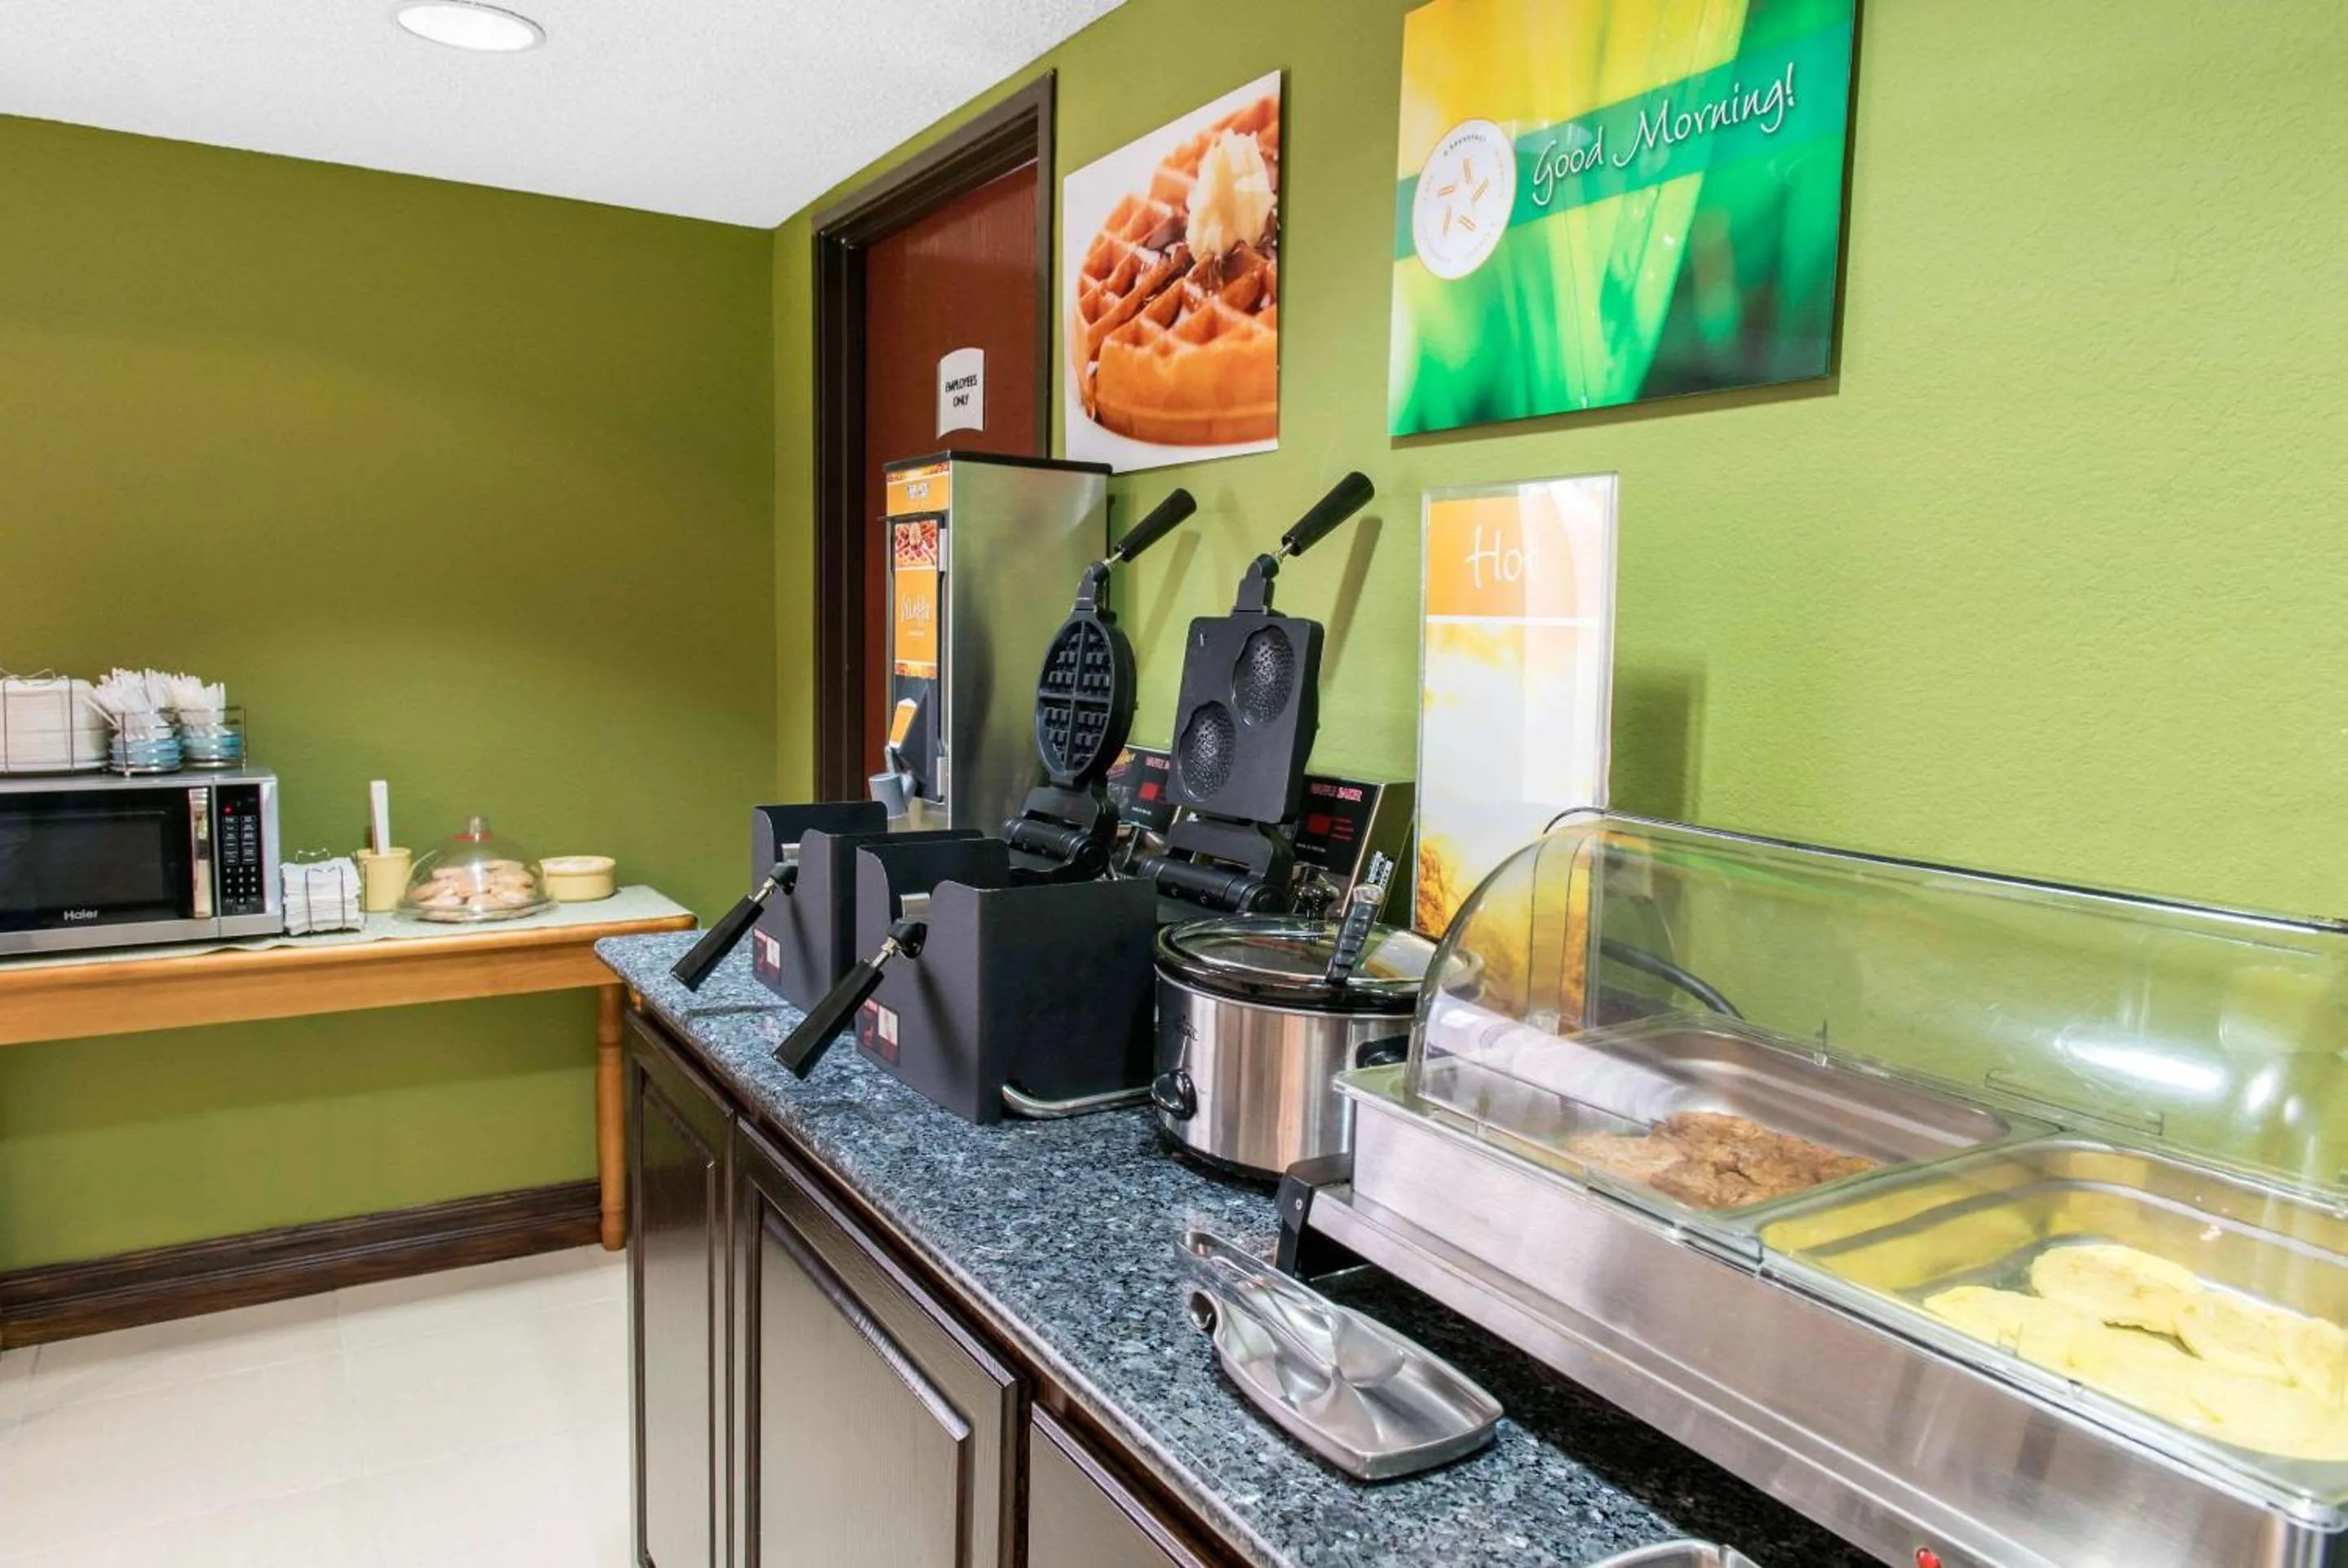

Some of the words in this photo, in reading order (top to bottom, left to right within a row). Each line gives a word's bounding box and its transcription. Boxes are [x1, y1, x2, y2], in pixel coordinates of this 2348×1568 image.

[1532, 125, 1603, 206] Good
[1612, 61, 1795, 168] Morning!
[944, 373, 978, 393] EMPLOYEES
[953, 393, 970, 408] ONLY
[63, 908, 98, 921] Haier
